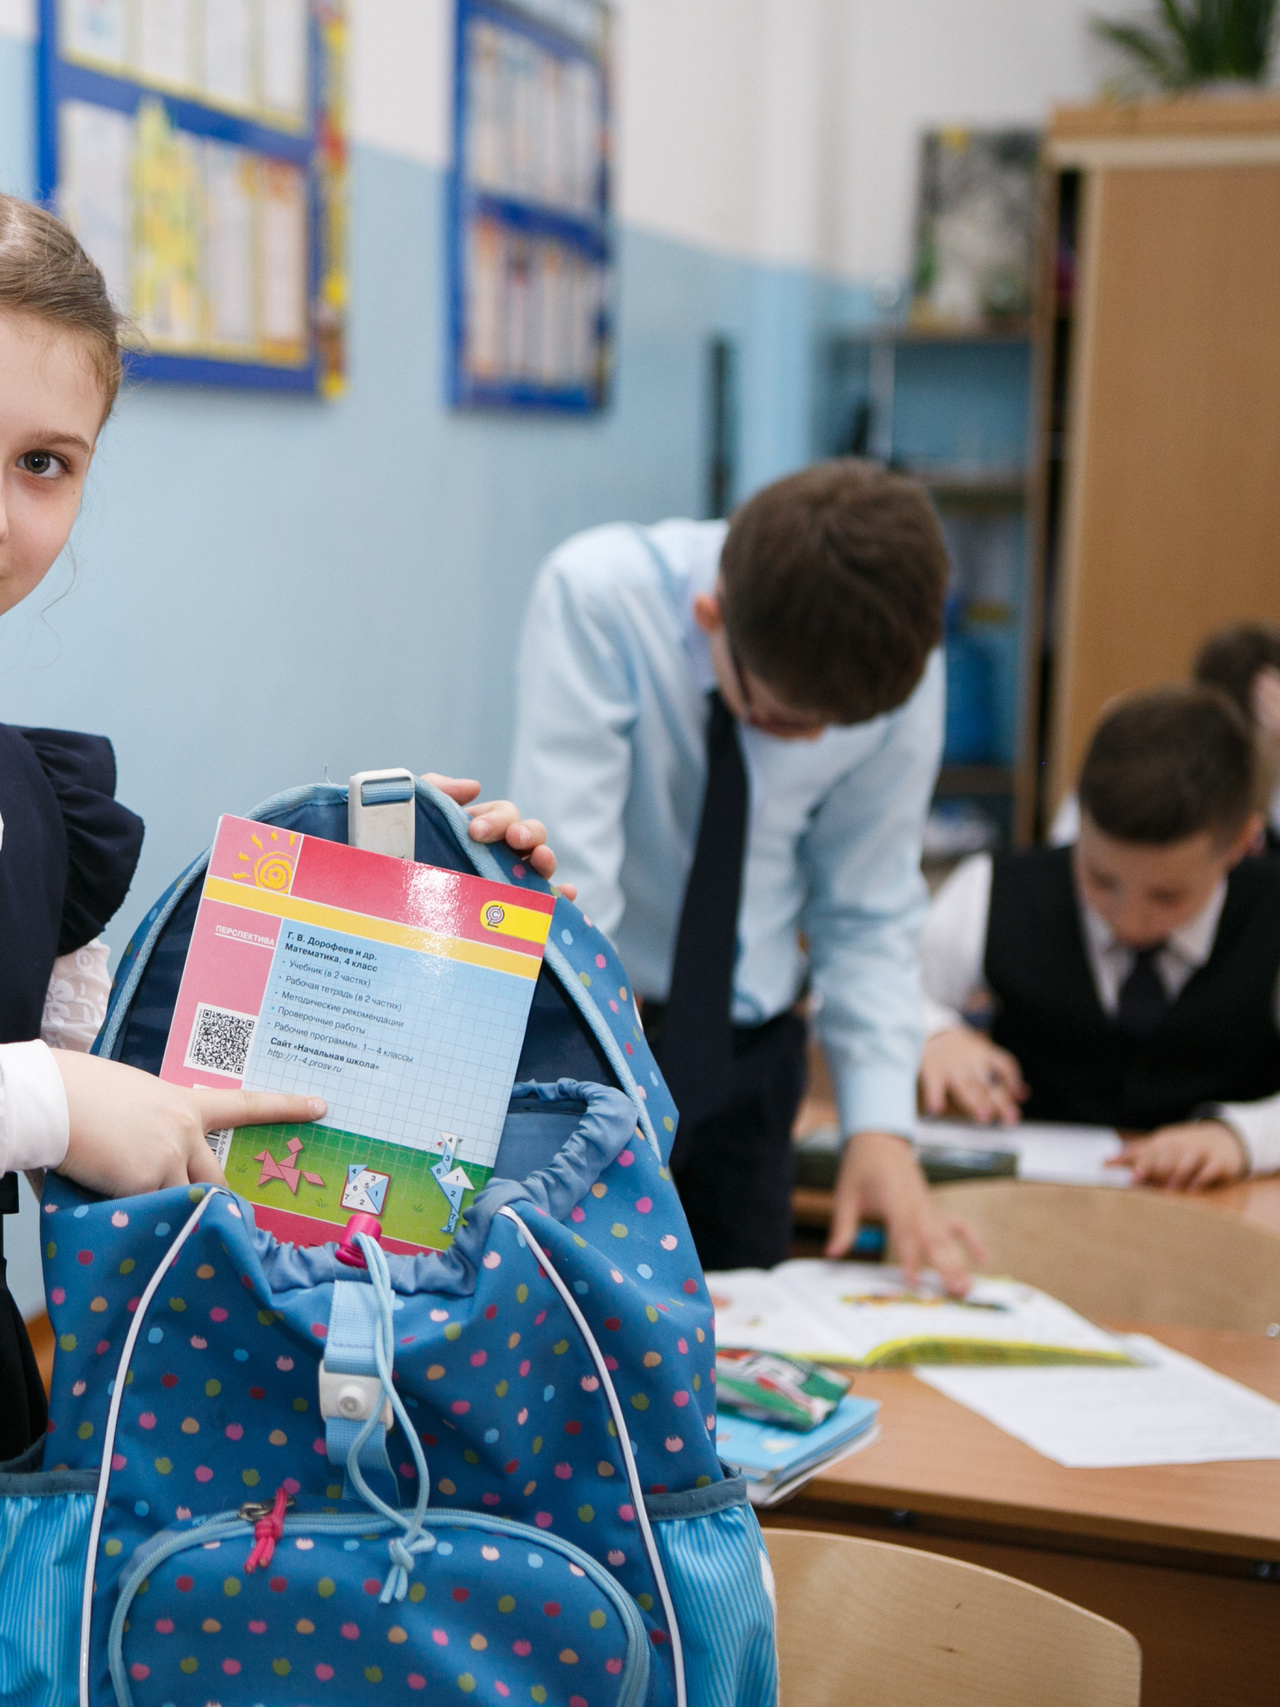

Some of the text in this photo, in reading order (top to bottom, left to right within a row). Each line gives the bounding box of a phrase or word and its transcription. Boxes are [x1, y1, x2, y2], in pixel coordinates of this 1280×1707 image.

[215, 925, 275, 946] ПЕРСПЕКТИВА
[287, 931, 294, 940] Г.
[297, 934, 306, 943] В.
[307, 936, 354, 955] Дорофеев
[362, 952, 377, 961] др.
[285, 943, 342, 964] Математика.
[351, 961, 378, 973] класс
[289, 960, 371, 988] Учебник (в 2 частях)
[286, 975, 402, 1012] Рабочая тетрадь (в 2 частях)
[278, 1006, 366, 1034] Проверочные работы
[281, 990, 404, 1028] Методические рекомендации
[270, 1037, 379, 1070] Сайт «Начальная школа»
[274, 1021, 308, 1036] Рабочие
[310, 1031, 359, 1050] программы.
[383, 1049, 414, 1063] классы
[267, 1048, 342, 1073] http://1-4.prosv.ru
